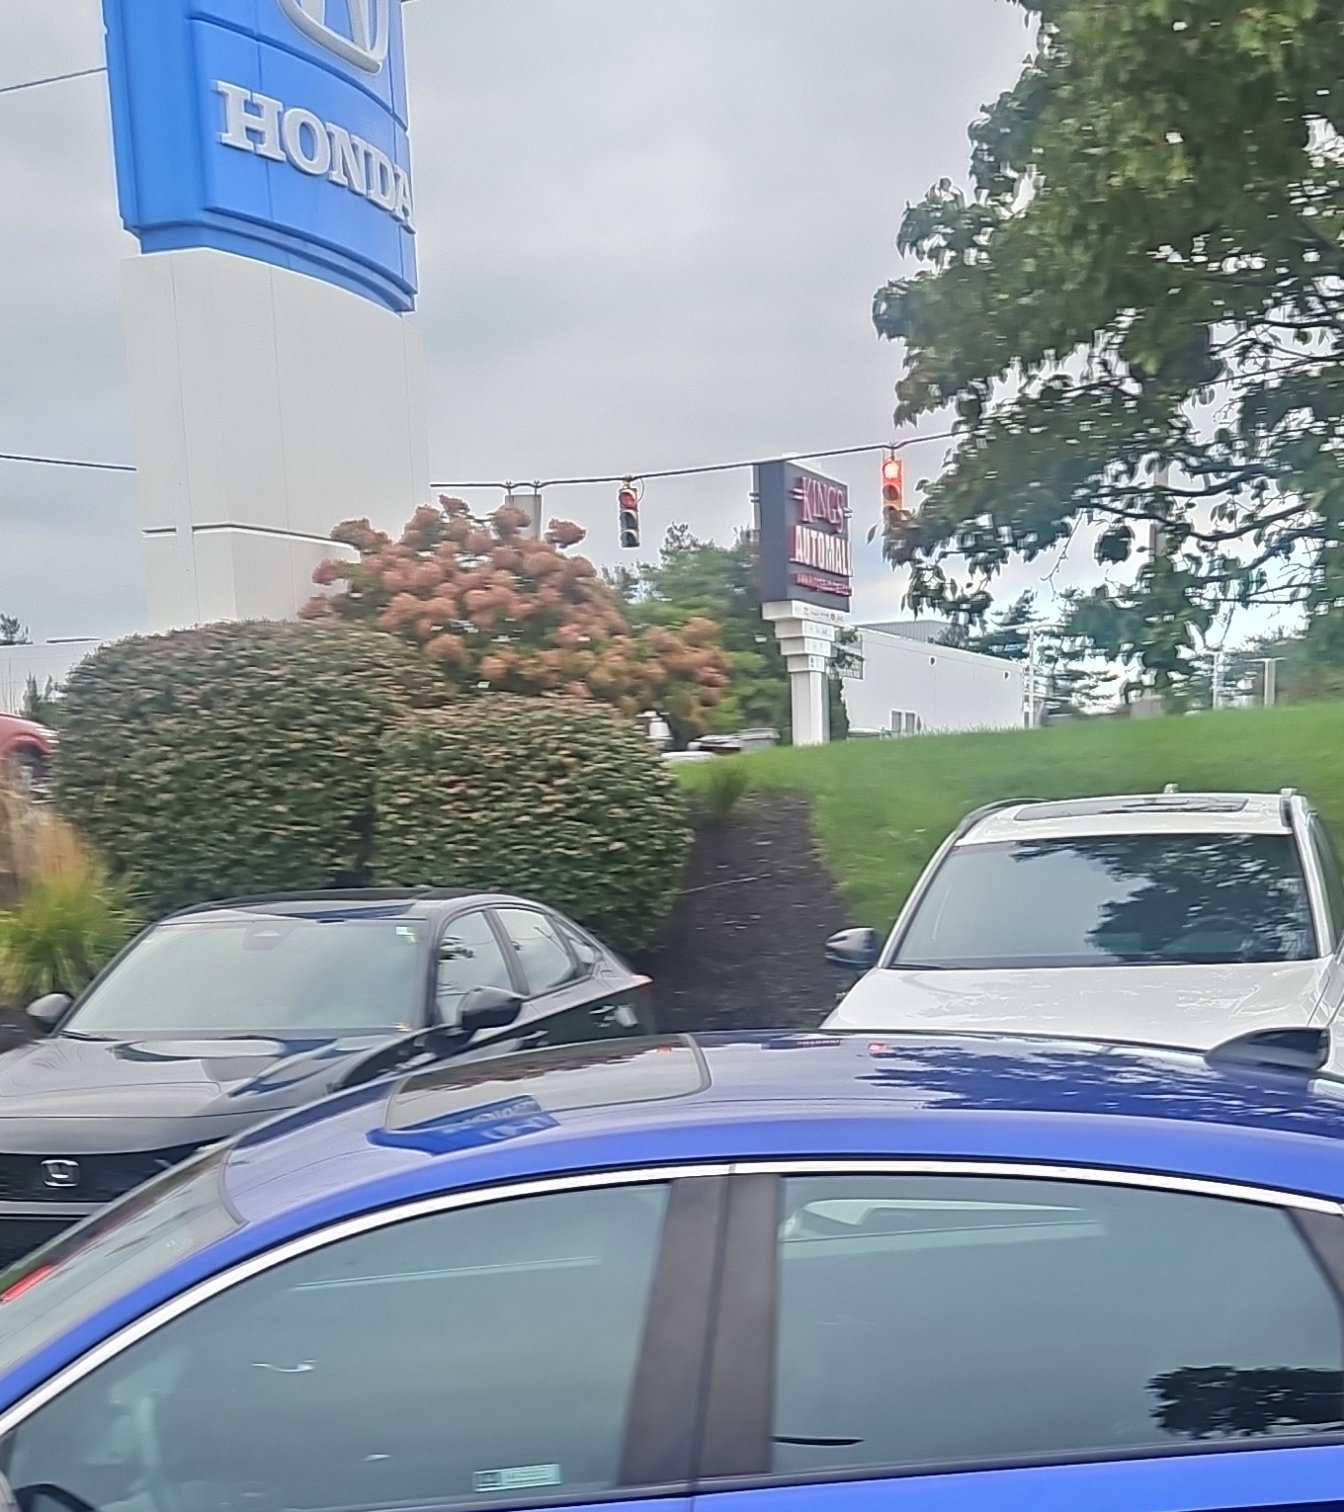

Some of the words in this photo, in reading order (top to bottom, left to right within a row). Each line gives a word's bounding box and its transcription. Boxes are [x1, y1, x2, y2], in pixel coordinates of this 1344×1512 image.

[213, 80, 416, 234] HONDA
[801, 476, 844, 534] KINGS
[794, 525, 853, 577] AUTOMALL
